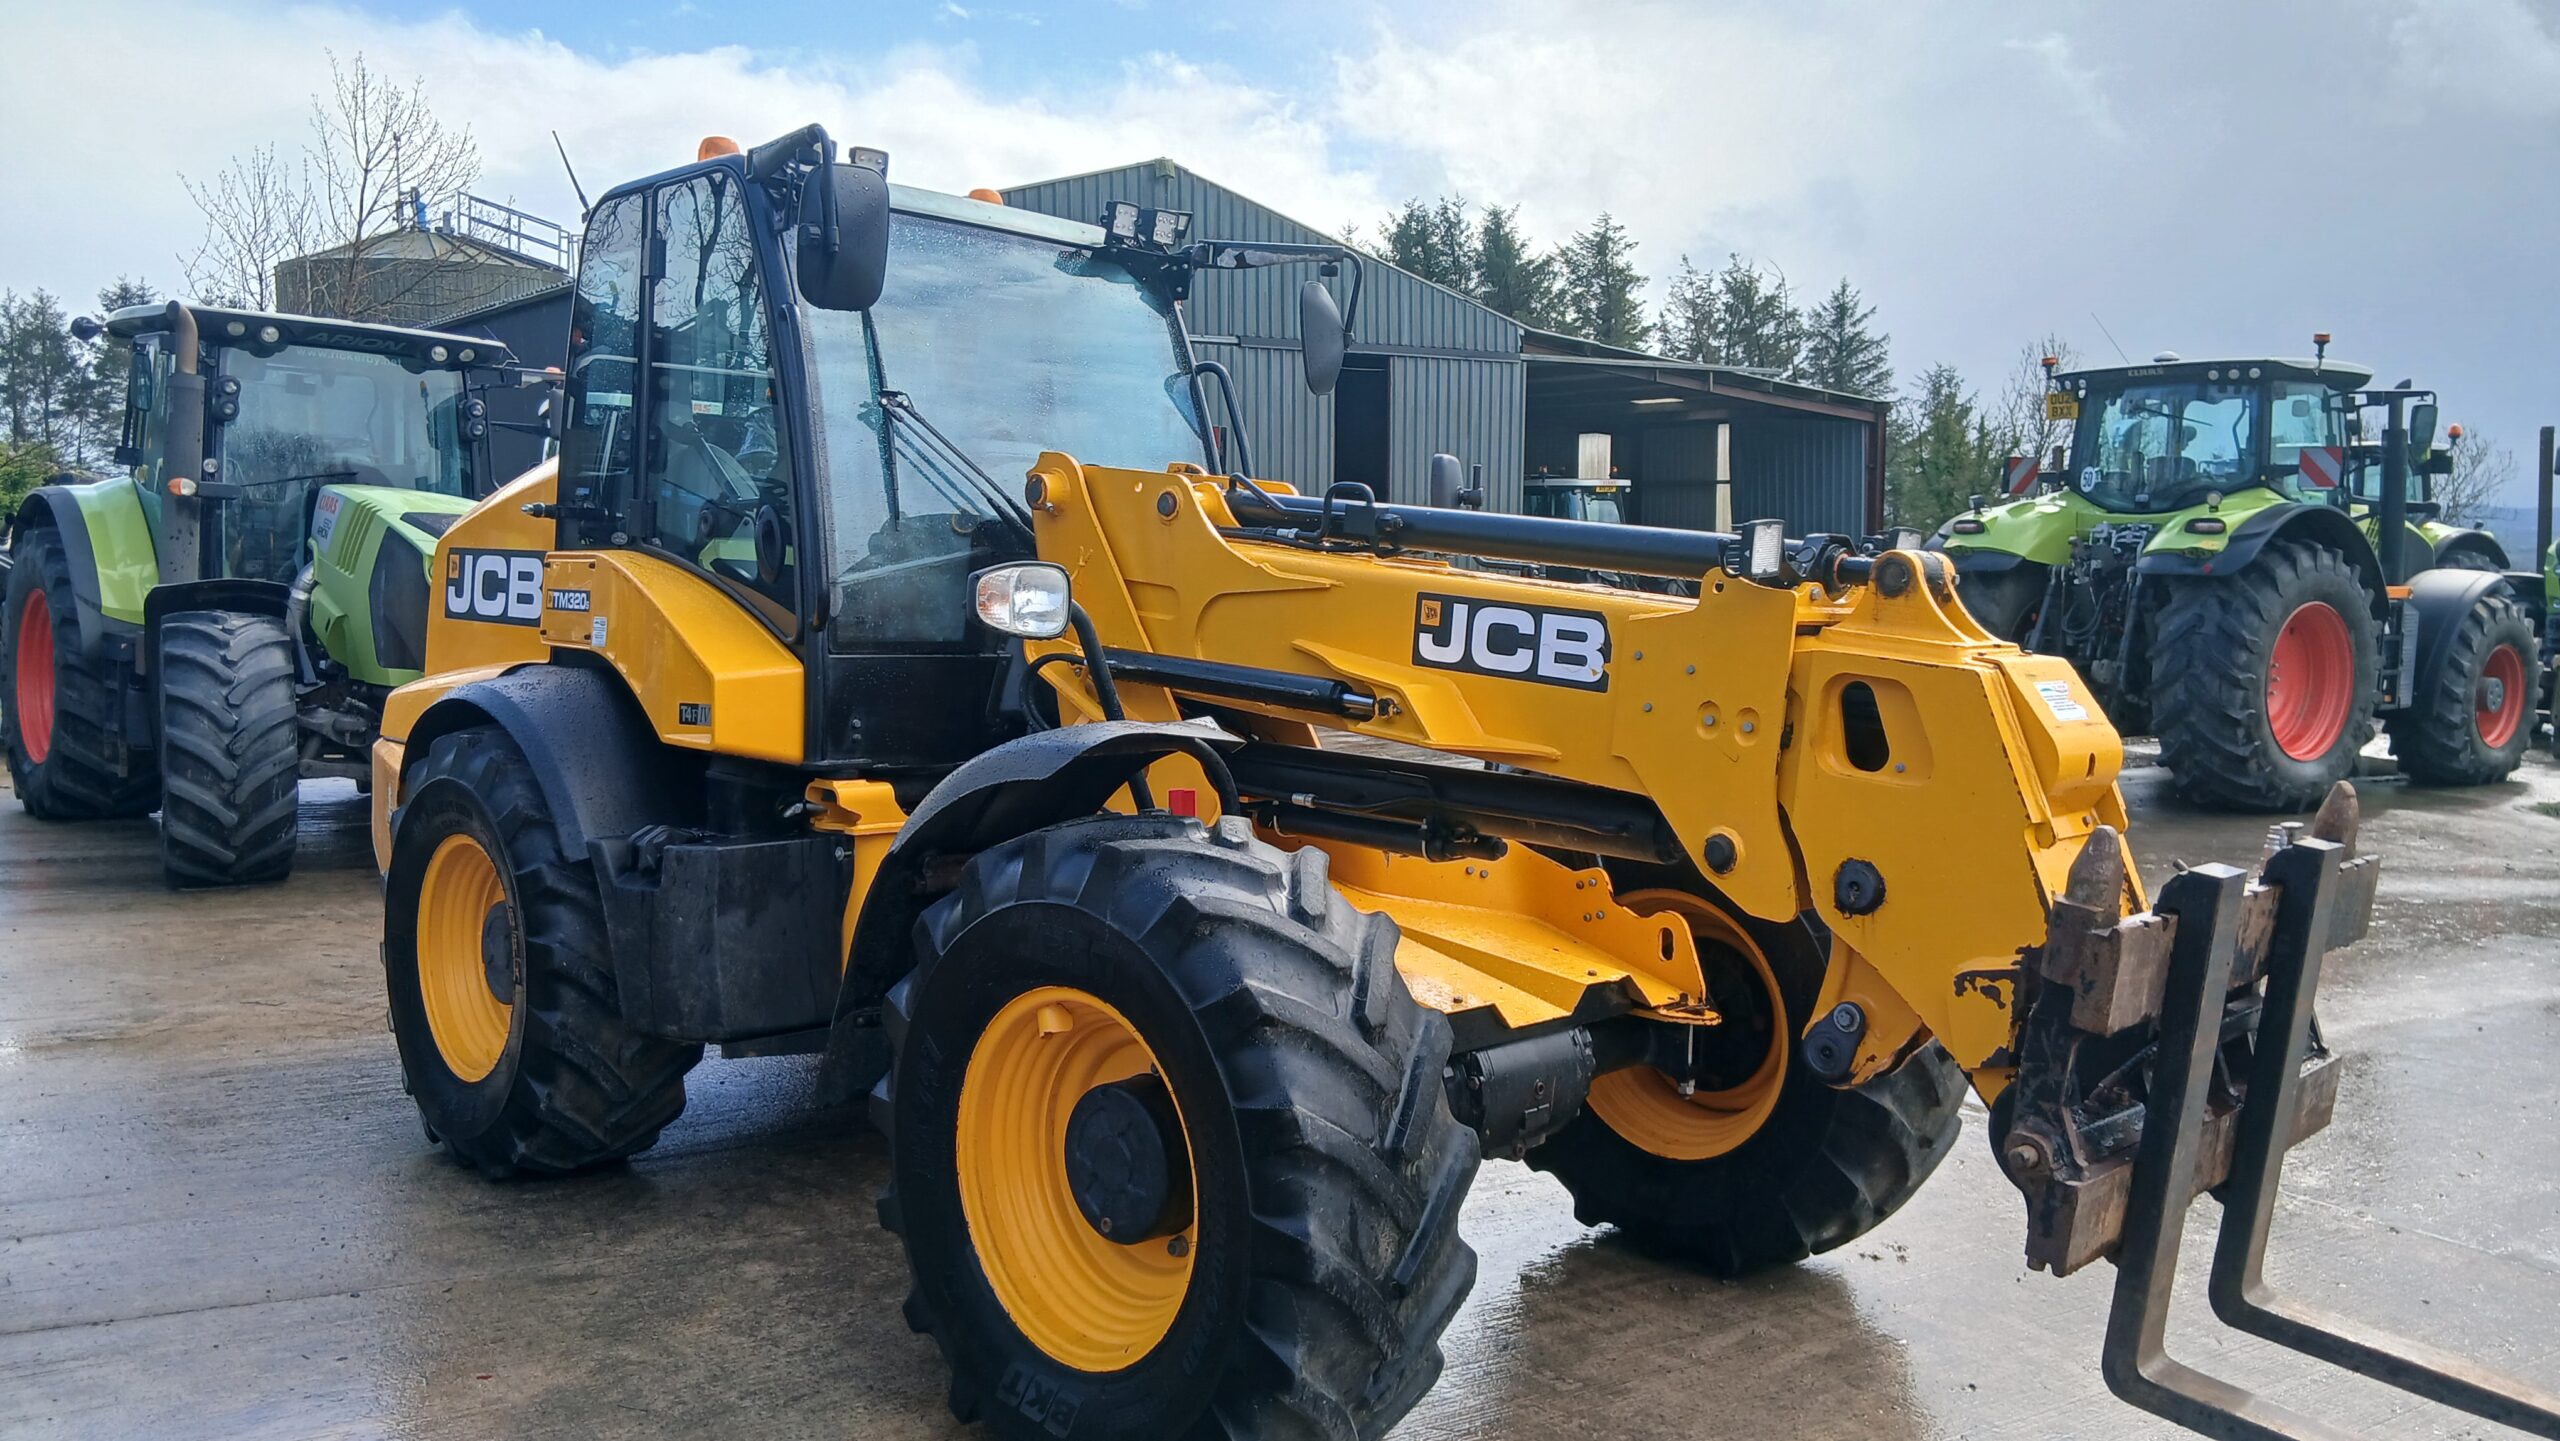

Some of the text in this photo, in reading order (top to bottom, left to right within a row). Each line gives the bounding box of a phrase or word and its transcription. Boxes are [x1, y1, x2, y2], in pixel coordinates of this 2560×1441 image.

[306, 332, 406, 350] ARION
[2082, 471, 2094, 488] 50
[447, 554, 544, 619] JCB
[1418, 602, 1606, 683] JCB
[998, 1364, 1083, 1437] BKT
